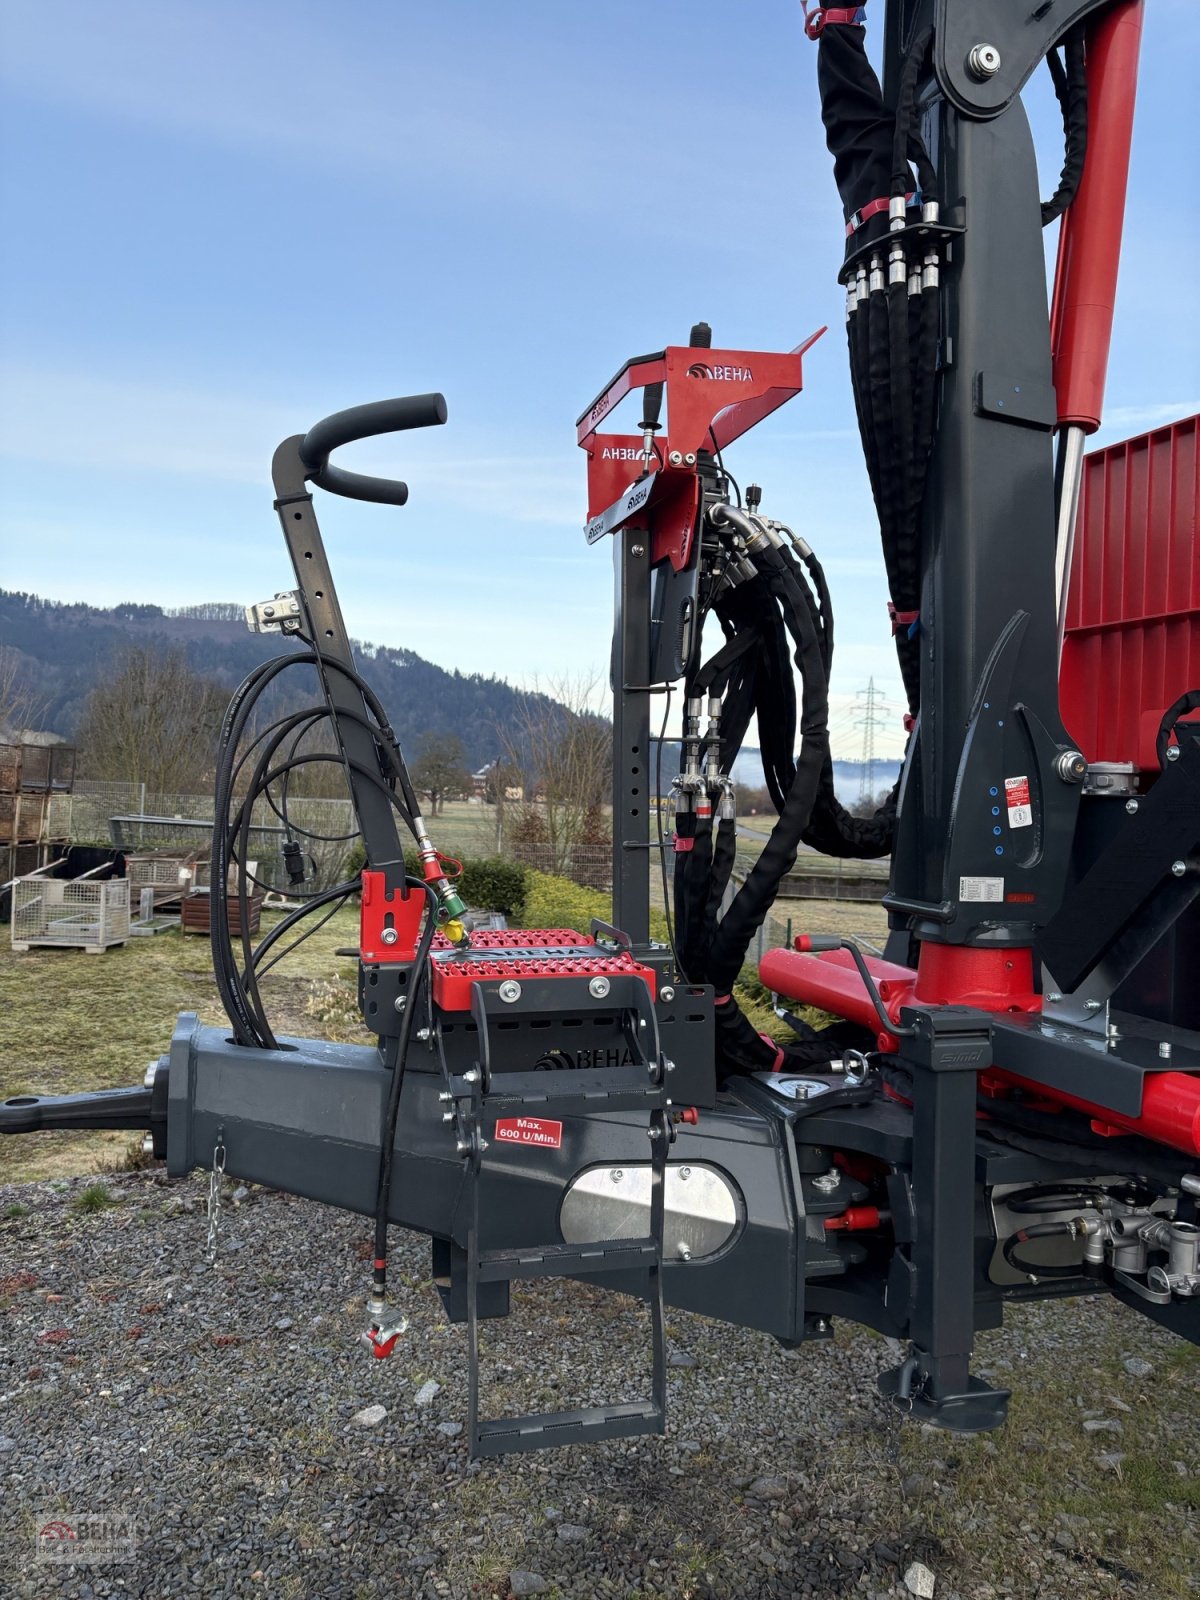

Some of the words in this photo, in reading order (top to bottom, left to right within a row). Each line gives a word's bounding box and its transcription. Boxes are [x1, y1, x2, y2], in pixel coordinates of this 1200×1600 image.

[713, 366, 753, 382] BEHA
[577, 1048, 637, 1069] BEHA
[517, 1119, 542, 1130] Max.
[500, 1128, 520, 1139] 600
[523, 1131, 557, 1144] U/Min.
